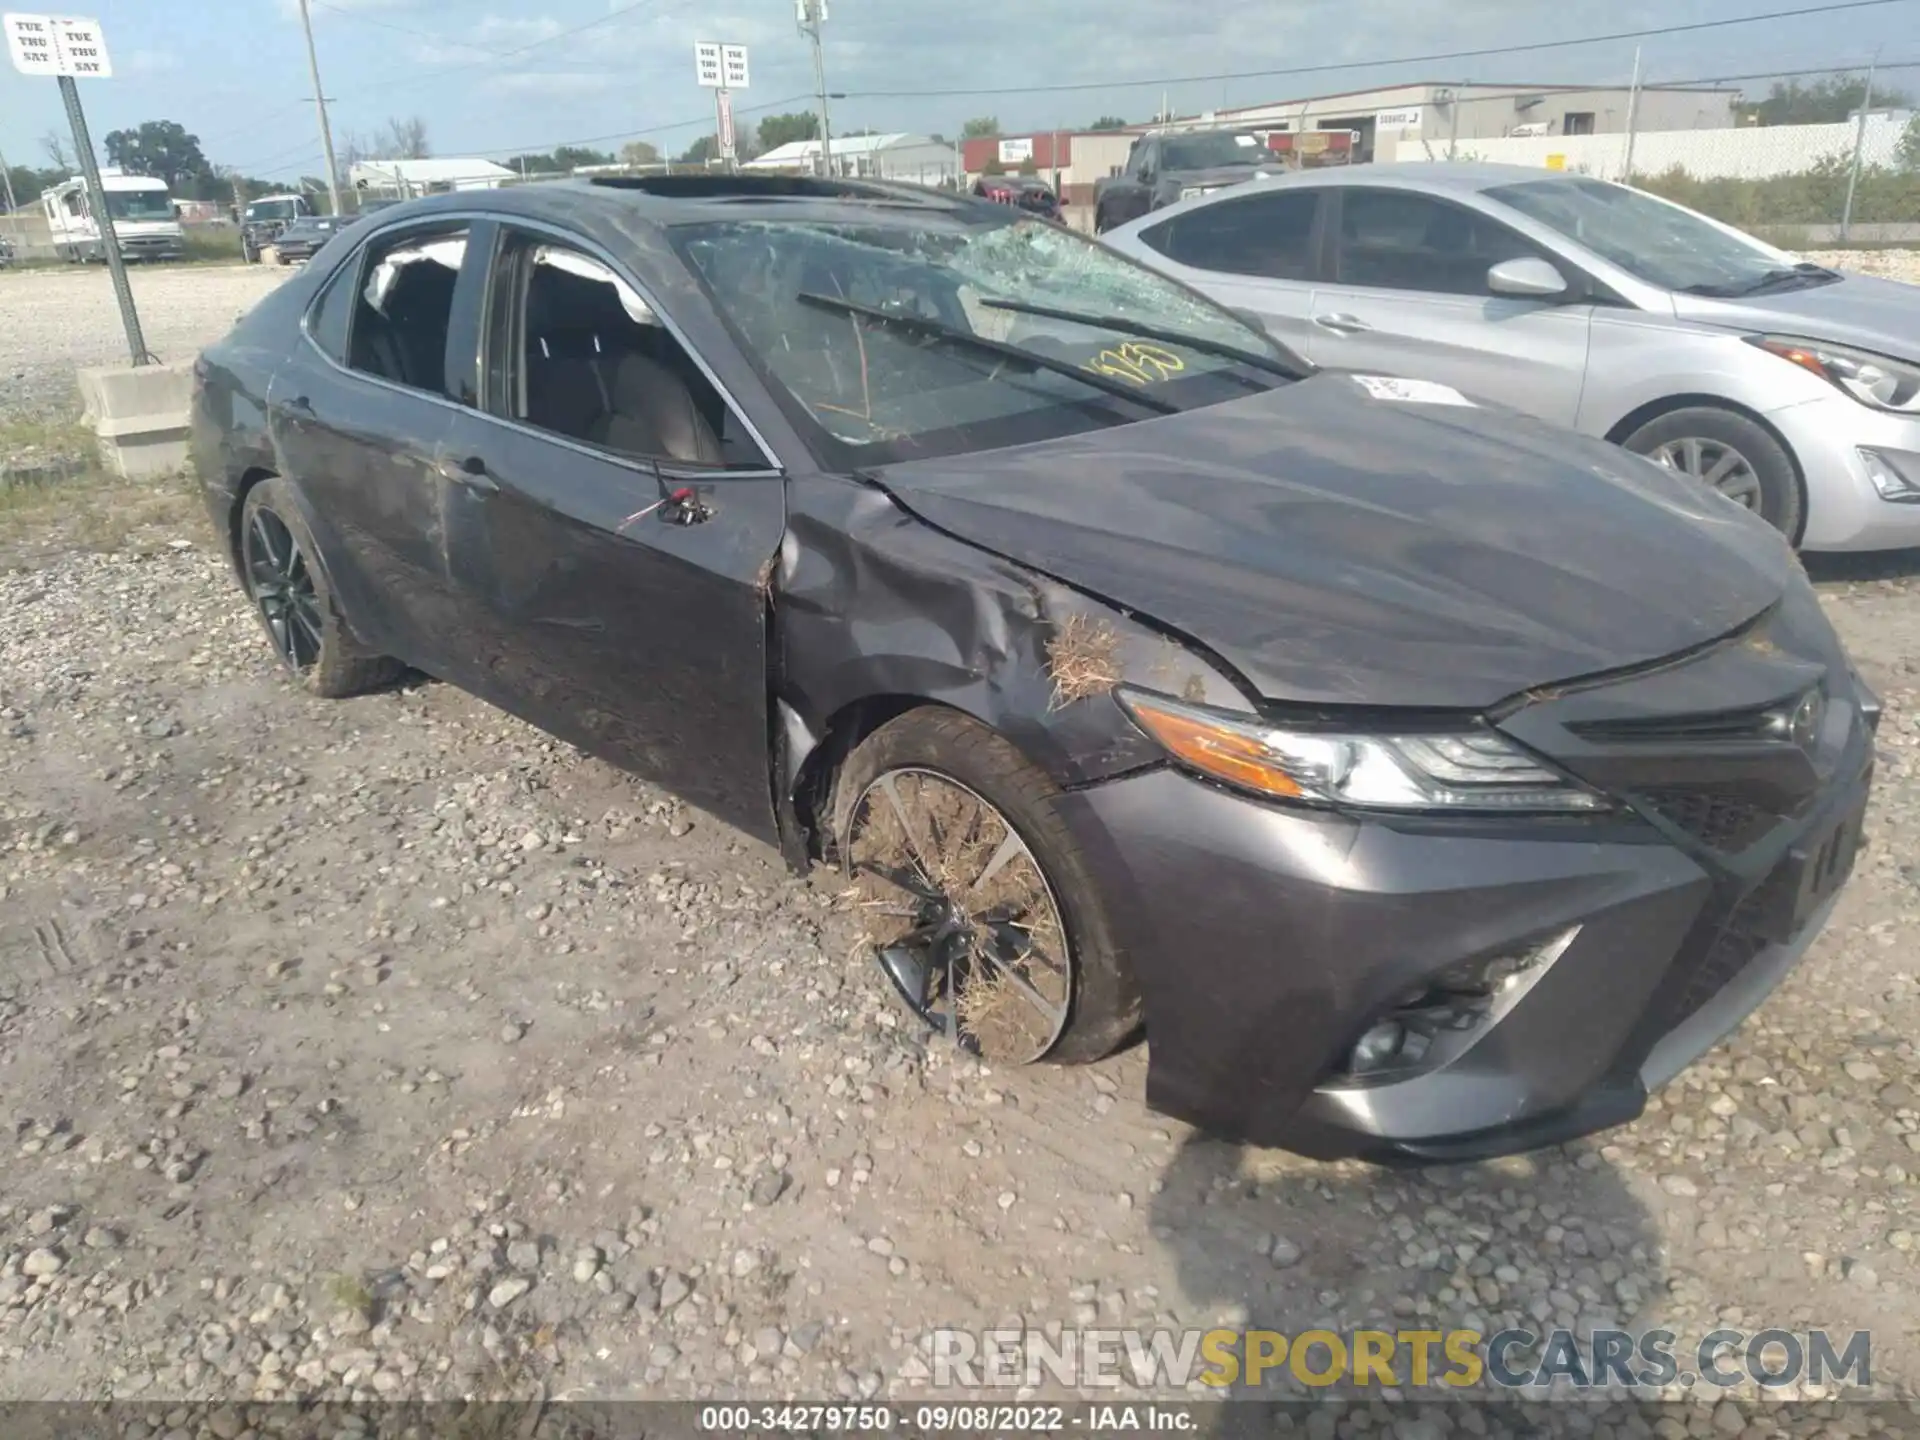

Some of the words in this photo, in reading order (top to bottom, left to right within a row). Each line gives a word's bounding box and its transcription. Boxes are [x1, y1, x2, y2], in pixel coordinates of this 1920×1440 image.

[16, 21, 44, 32] TUE
[18, 36, 47, 47] THU
[65, 32, 92, 41] TUE
[23, 52, 48, 62] SAT
[69, 47, 97, 57] THU
[74, 62, 100, 72] SAT
